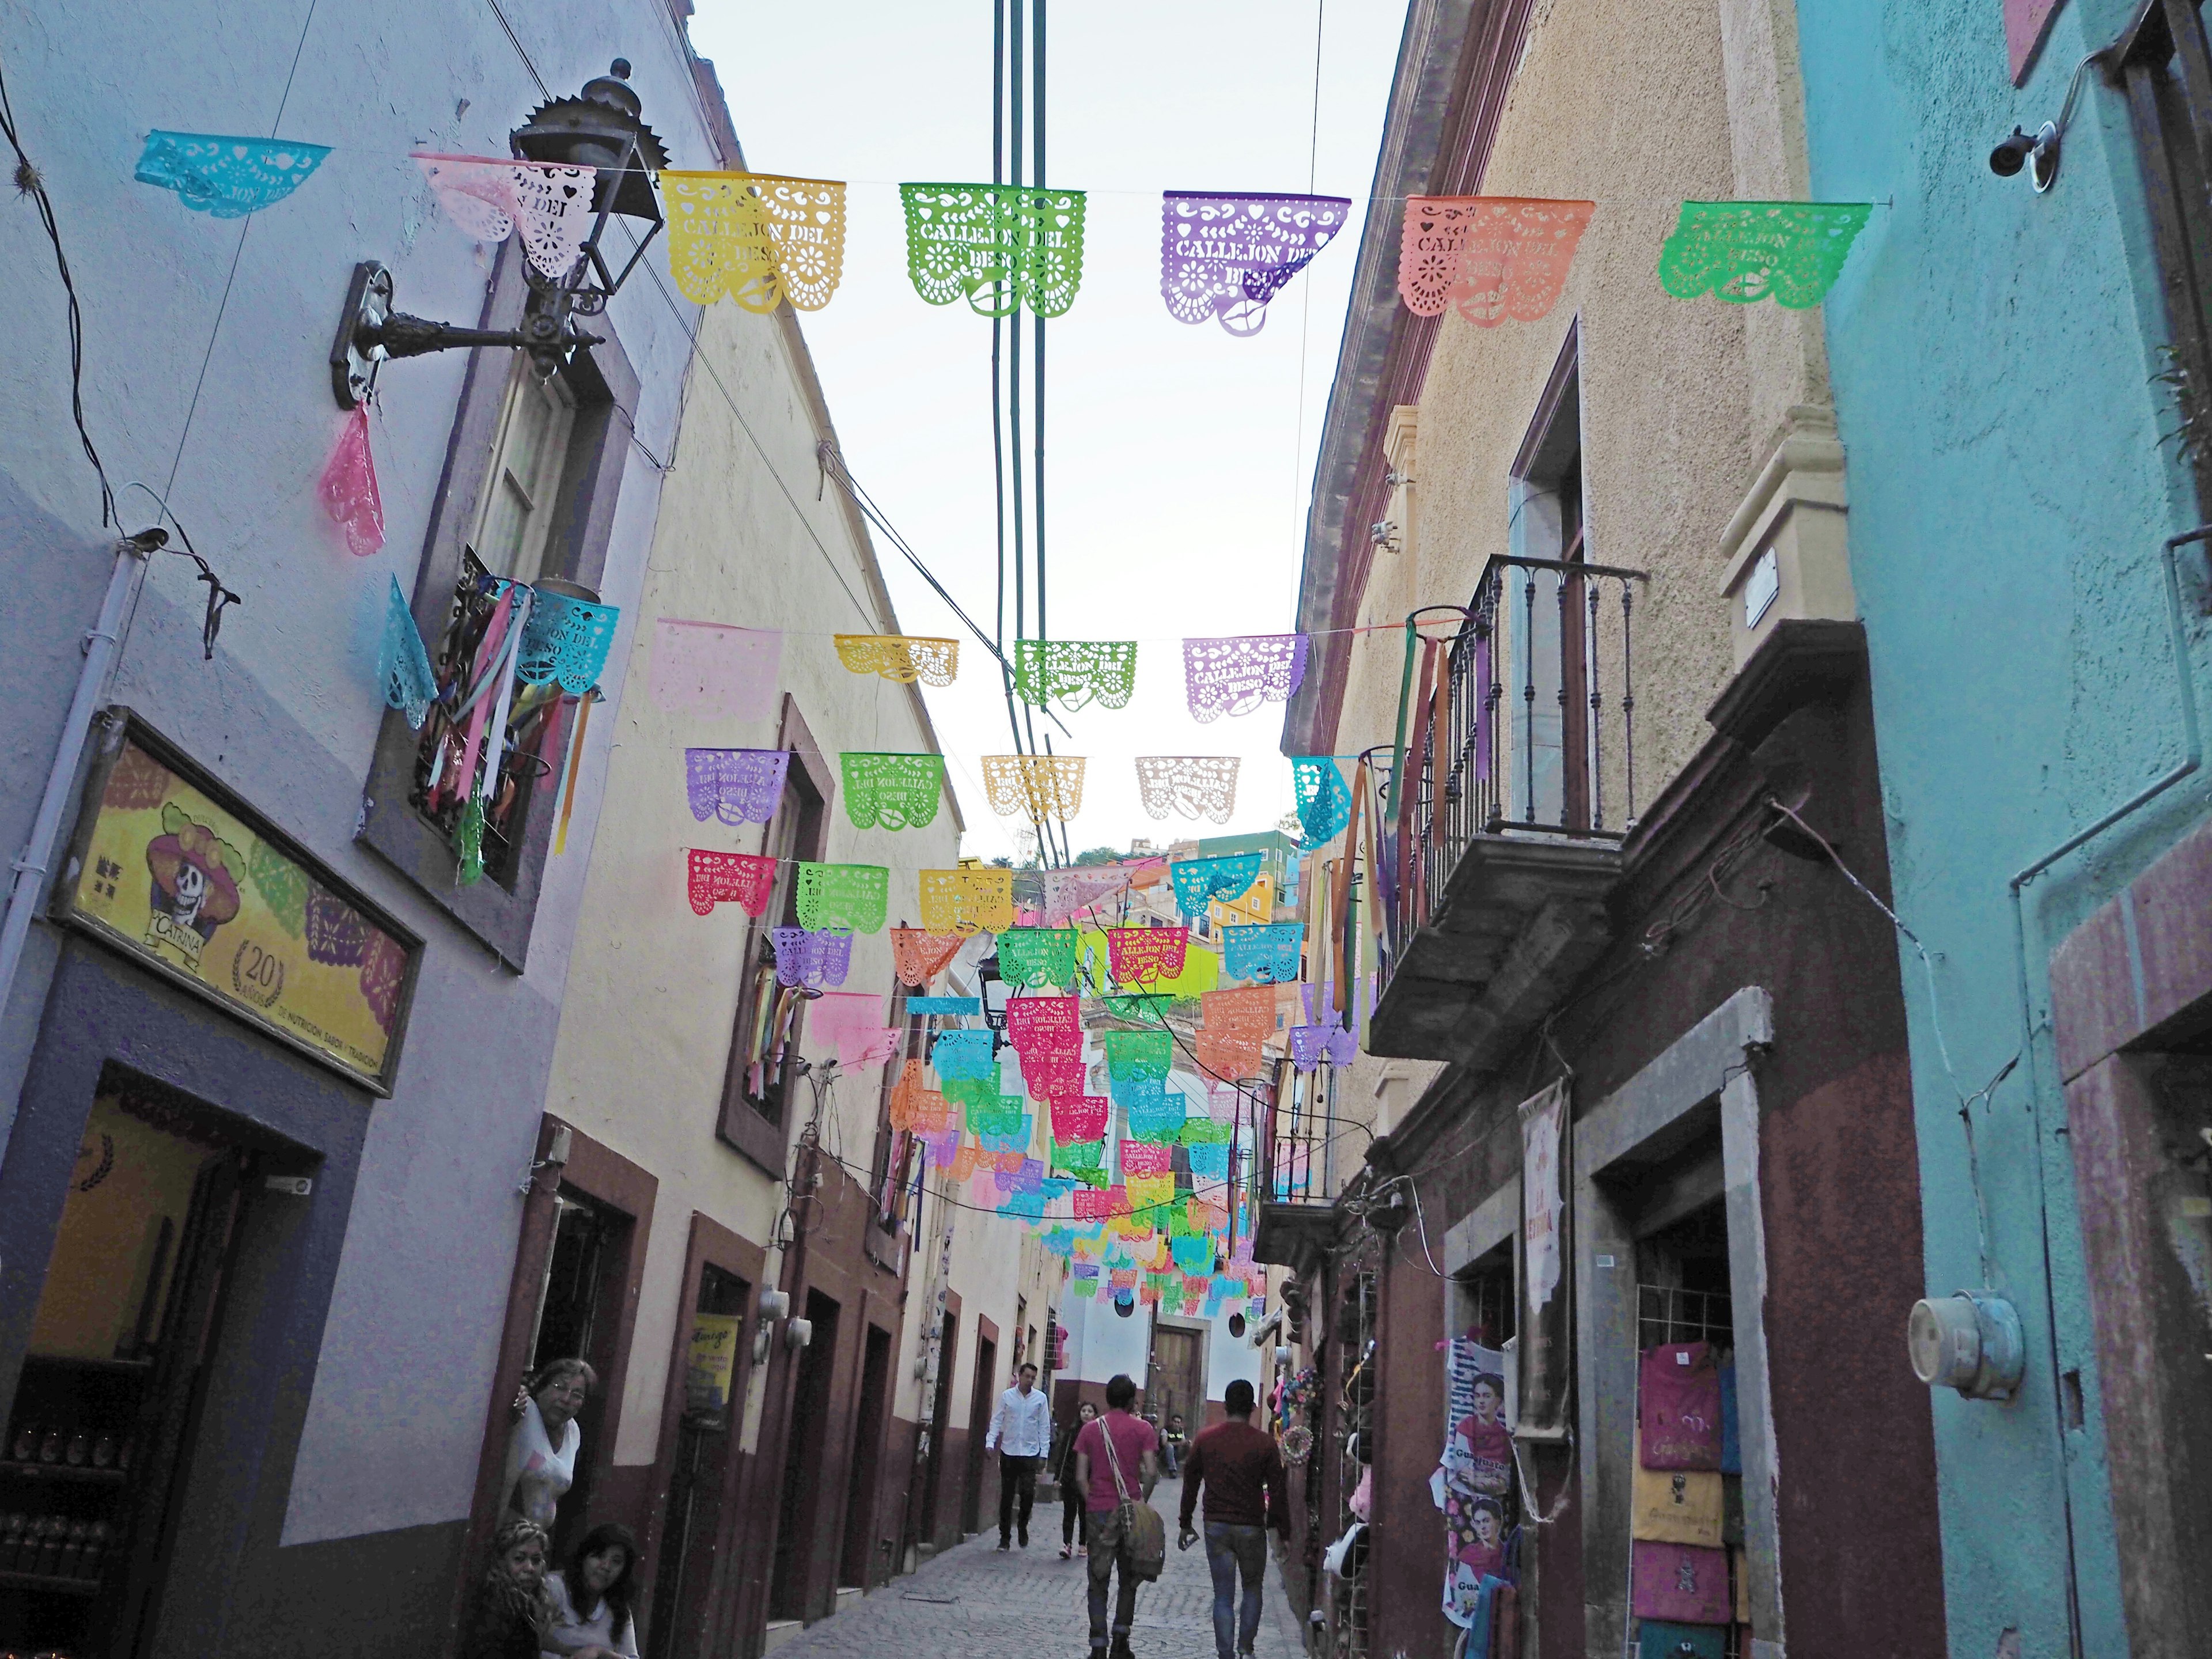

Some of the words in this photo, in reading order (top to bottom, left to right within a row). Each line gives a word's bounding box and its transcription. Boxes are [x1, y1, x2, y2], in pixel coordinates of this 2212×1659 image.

[790, 224, 829, 245] DEL
[920, 222, 1021, 247] CALLEJON
[1028, 230, 1068, 249] DEL
[969, 249, 1017, 269] BESO
[1176, 239, 1282, 264] CALLEJON
[571, 634, 599, 649] DEL
[1024, 660, 1095, 672] CALLEJON
[1099, 661, 1126, 672] DEL
[1194, 664, 1266, 684] CALLEJON
[1268, 660, 1293, 673] DEL
[1228, 679, 1263, 693] BESO
[157, 915, 200, 953] CATRINA
[245, 945, 276, 987] 20
[1137, 956, 1160, 964] BESO
[240, 984, 266, 1008] AÑOS
[1456, 1448, 1505, 1471] Guanajuato
